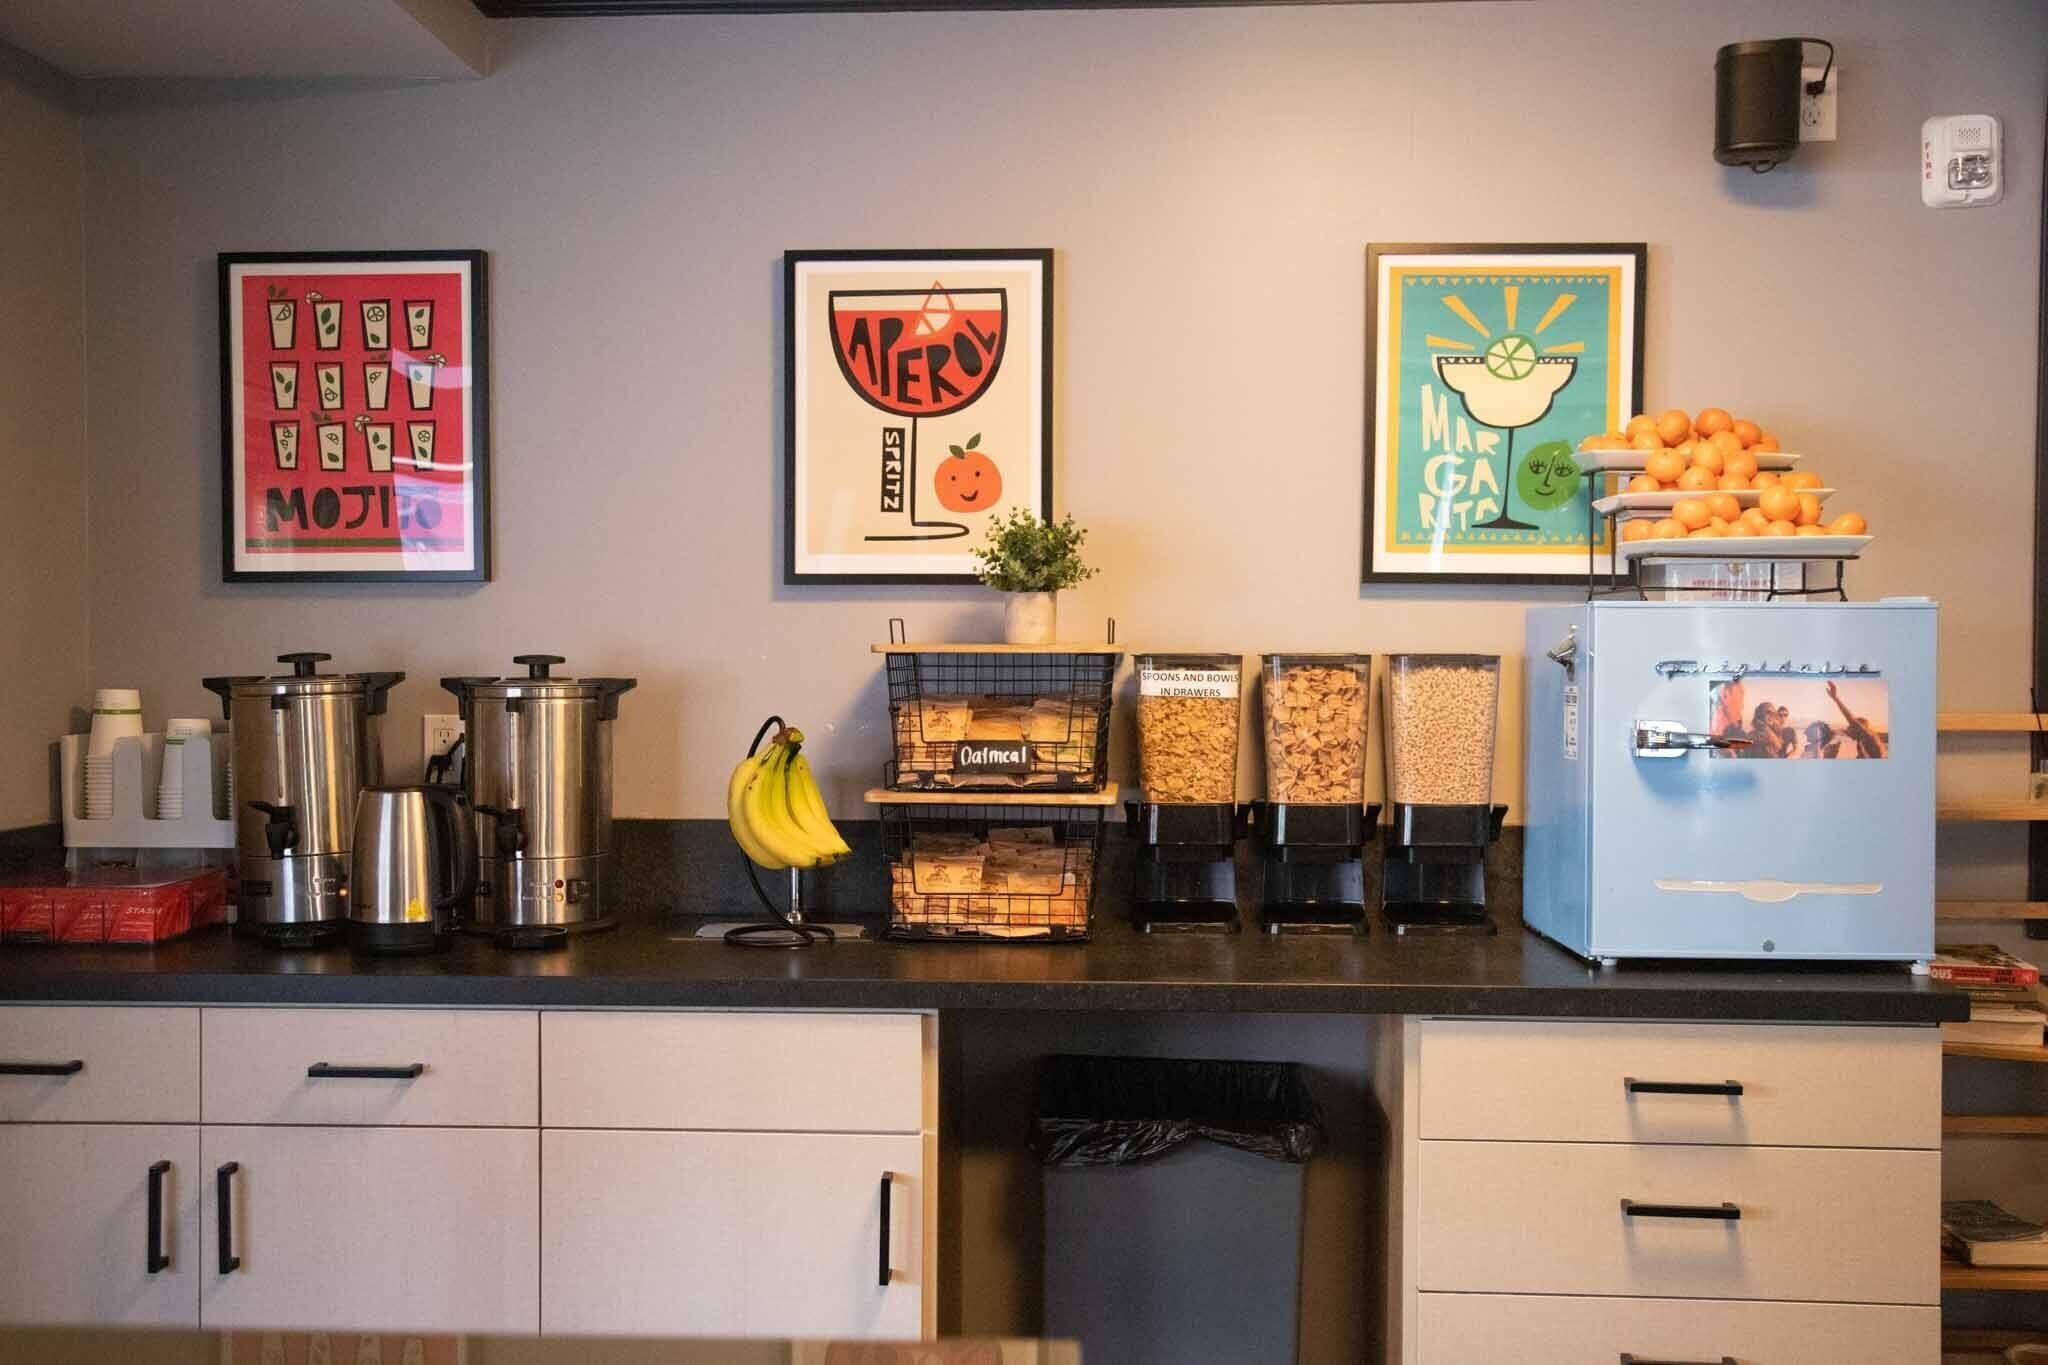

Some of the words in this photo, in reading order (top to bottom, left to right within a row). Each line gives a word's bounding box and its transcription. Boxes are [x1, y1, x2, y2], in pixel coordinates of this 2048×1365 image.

[1924, 142, 1934, 181] FIRE
[848, 317, 997, 406] APEROL
[1421, 384, 1502, 456] MAR
[883, 430, 903, 510] SPRITZ
[1424, 456, 1500, 497] GA
[265, 485, 443, 532] MOJITO
[1418, 491, 1500, 531] RITA
[1142, 671, 1180, 682] SPOONS
[1183, 673, 1204, 682] AND
[1207, 673, 1241, 683] BOWLS
[1655, 660, 1881, 682] Frigidaire
[1160, 687, 1171, 696] IN
[1174, 688, 1221, 697] DRAWERS
[960, 746, 1027, 766] Oatmeal
[1929, 967, 1953, 980] OUS
